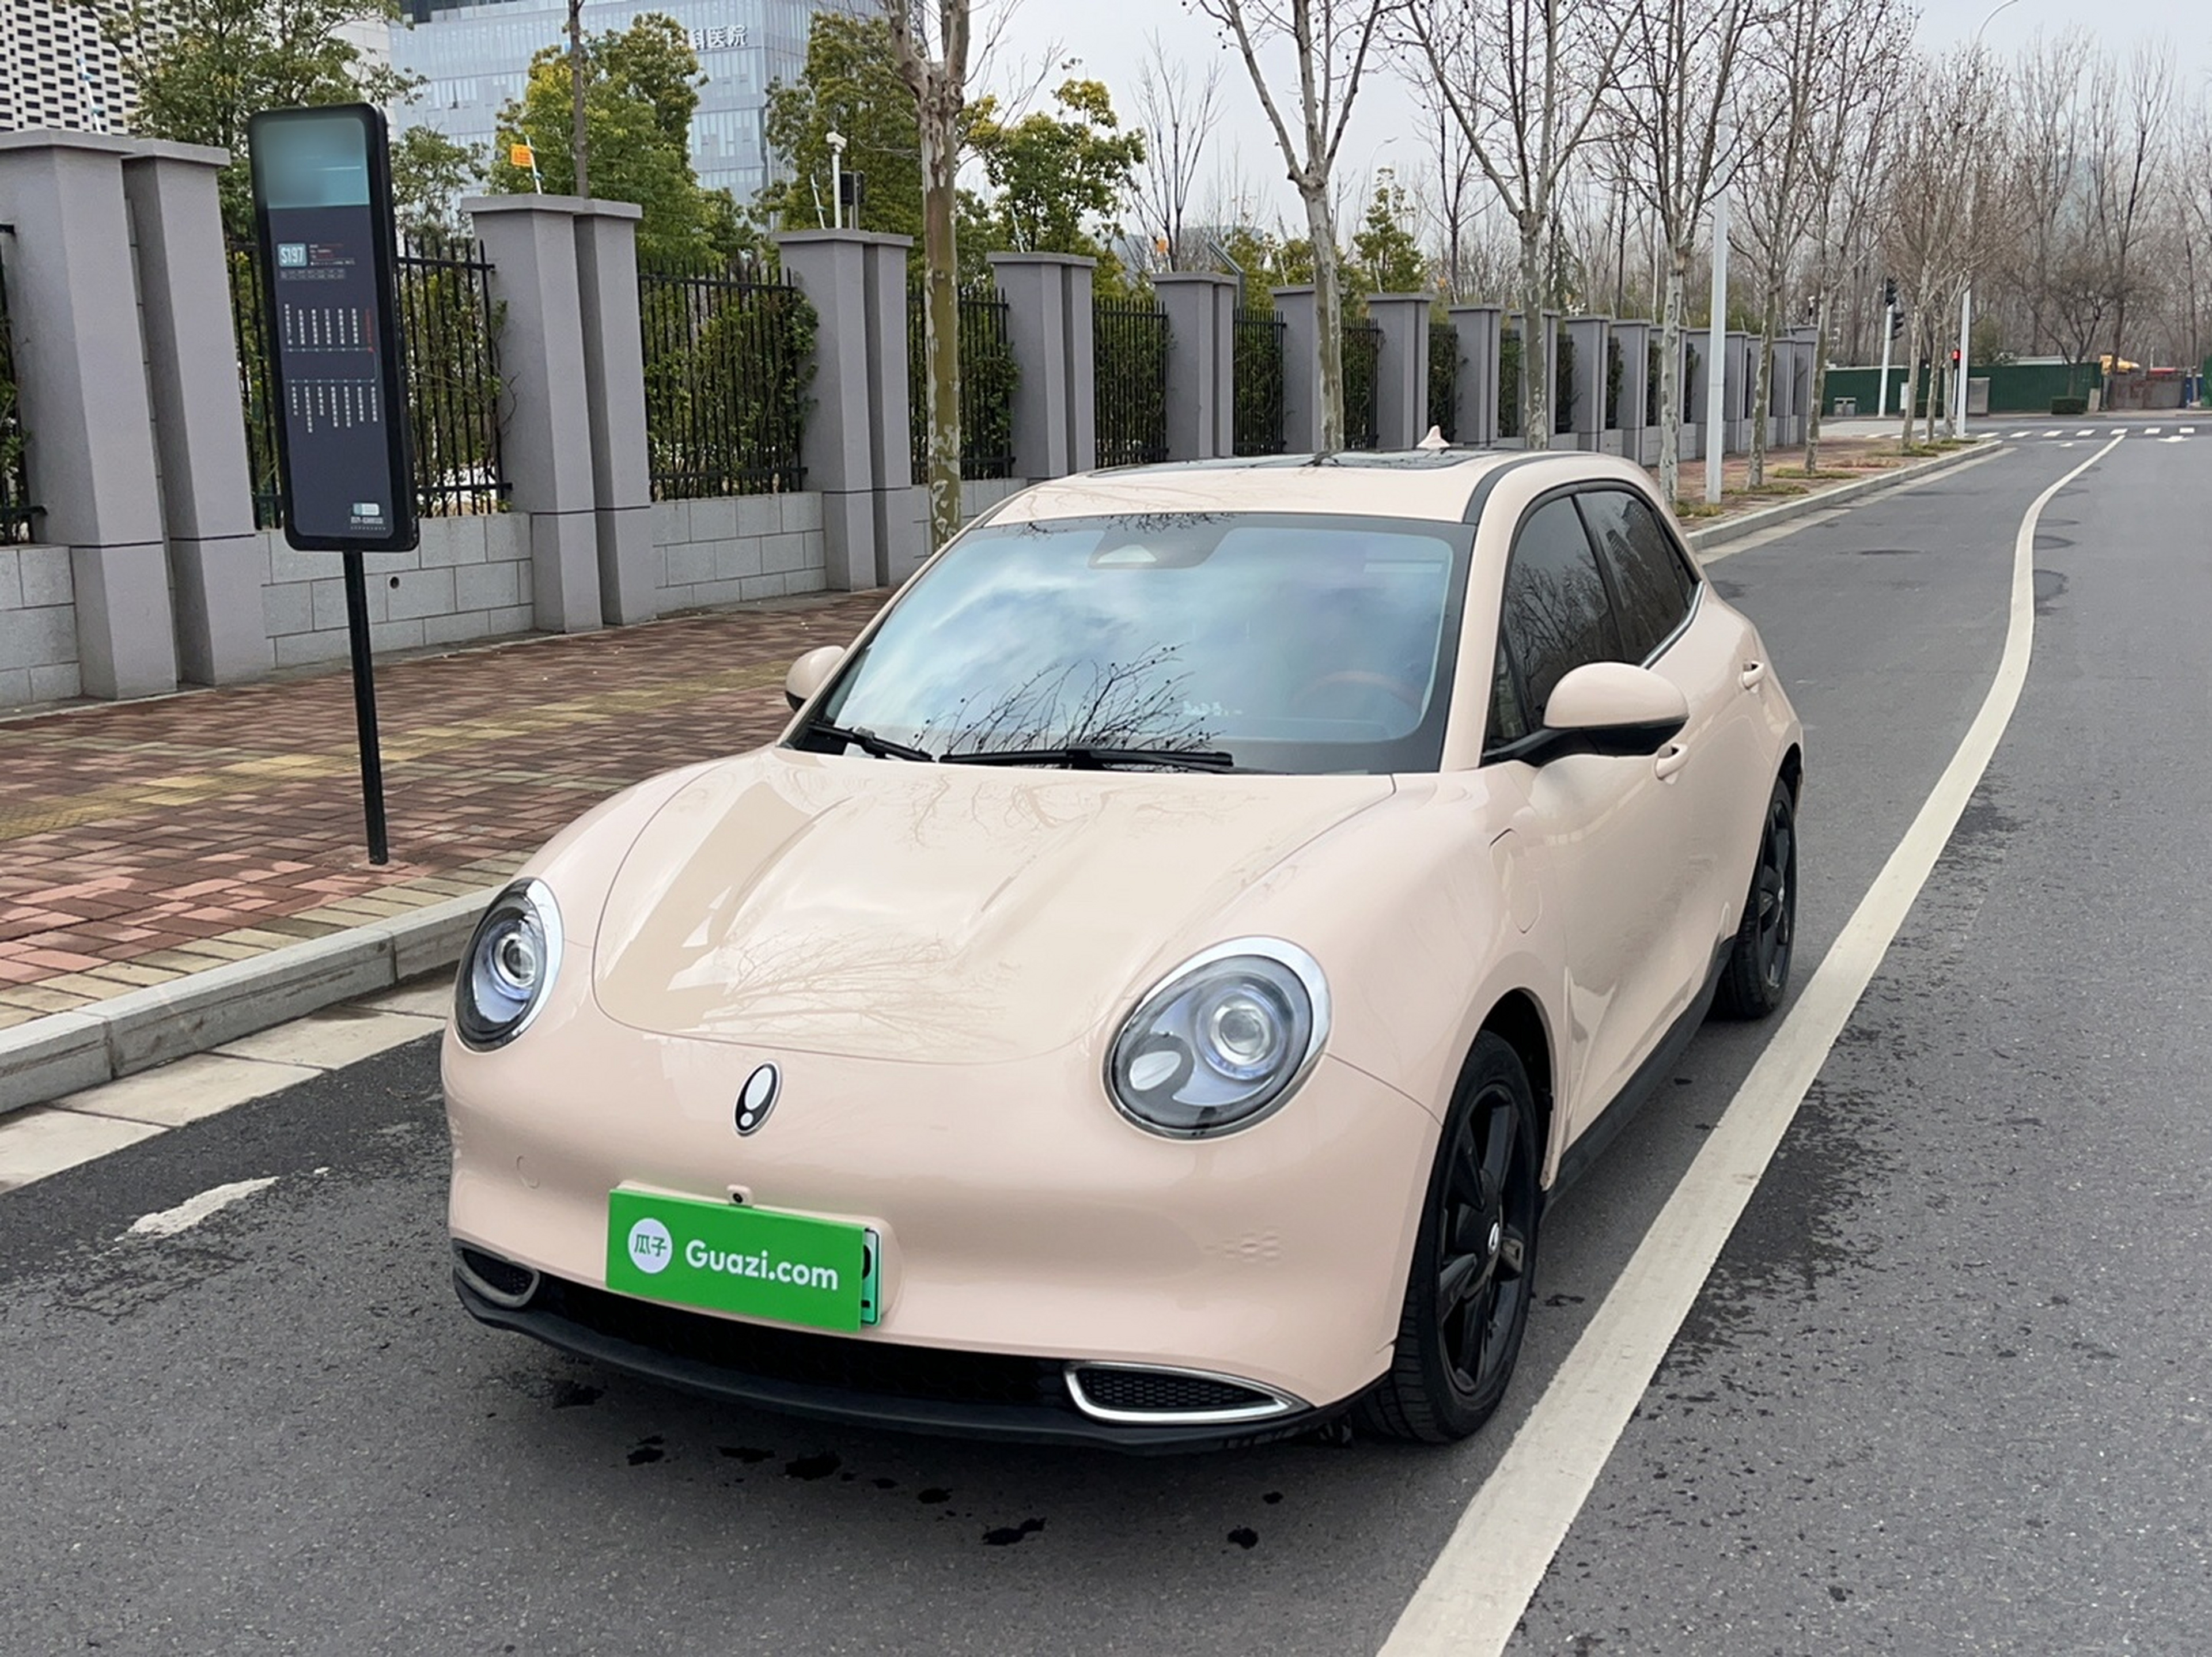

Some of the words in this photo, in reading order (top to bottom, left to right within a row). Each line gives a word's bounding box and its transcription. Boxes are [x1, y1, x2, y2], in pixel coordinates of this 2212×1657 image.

[280, 247, 304, 264] S197
[634, 1234, 667, 1257] 瓜子
[685, 1239, 839, 1291] Guazi.com
